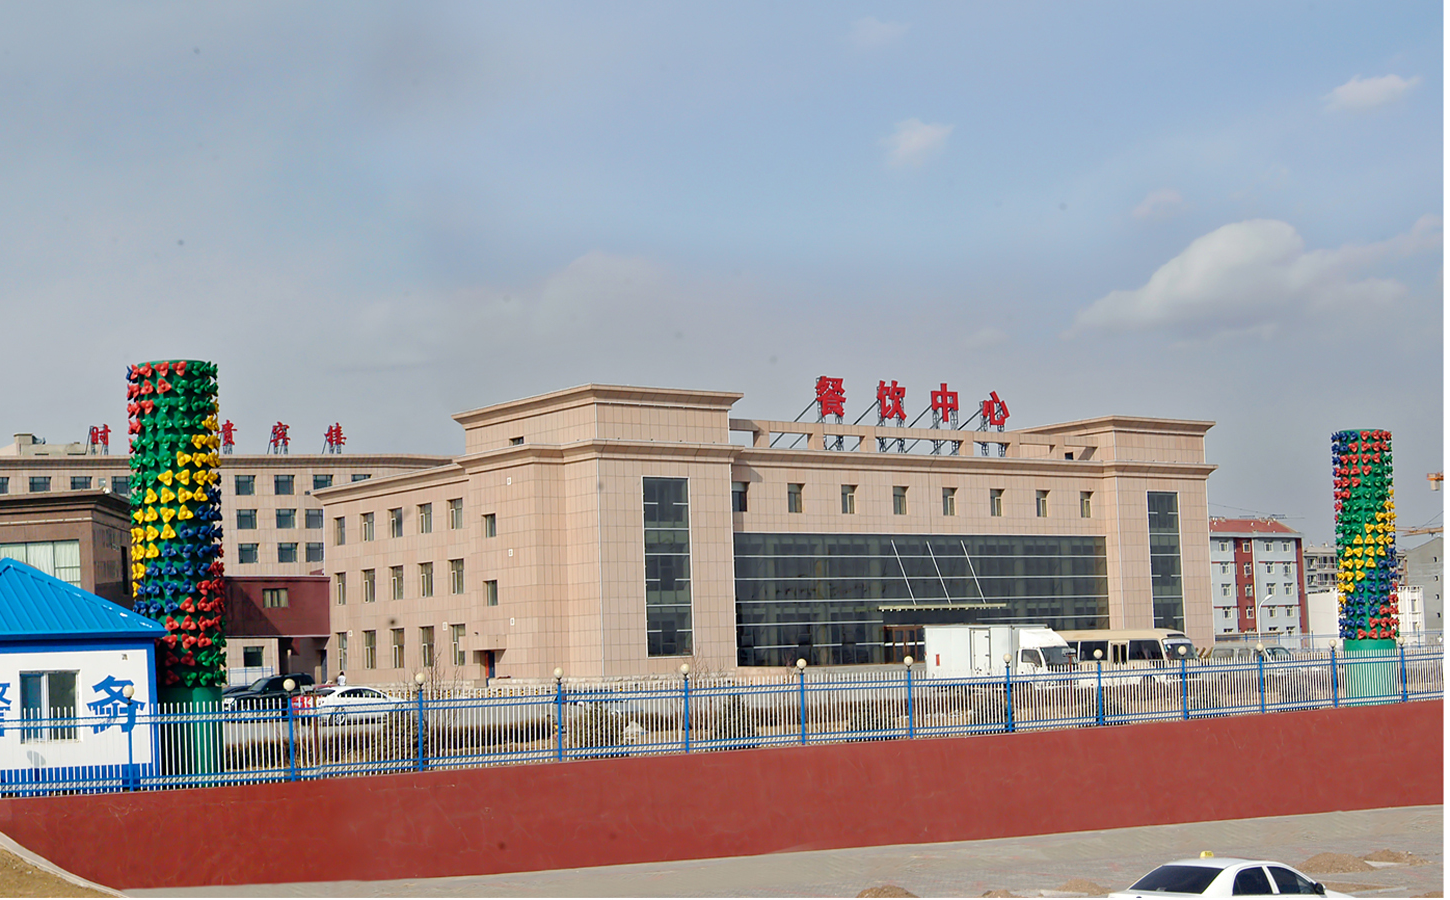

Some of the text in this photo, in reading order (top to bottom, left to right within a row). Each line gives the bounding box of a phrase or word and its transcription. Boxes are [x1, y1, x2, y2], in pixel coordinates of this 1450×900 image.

[815, 375, 1010, 426] 餐饮中心
[90, 418, 348, 447] 时贵宾楼
